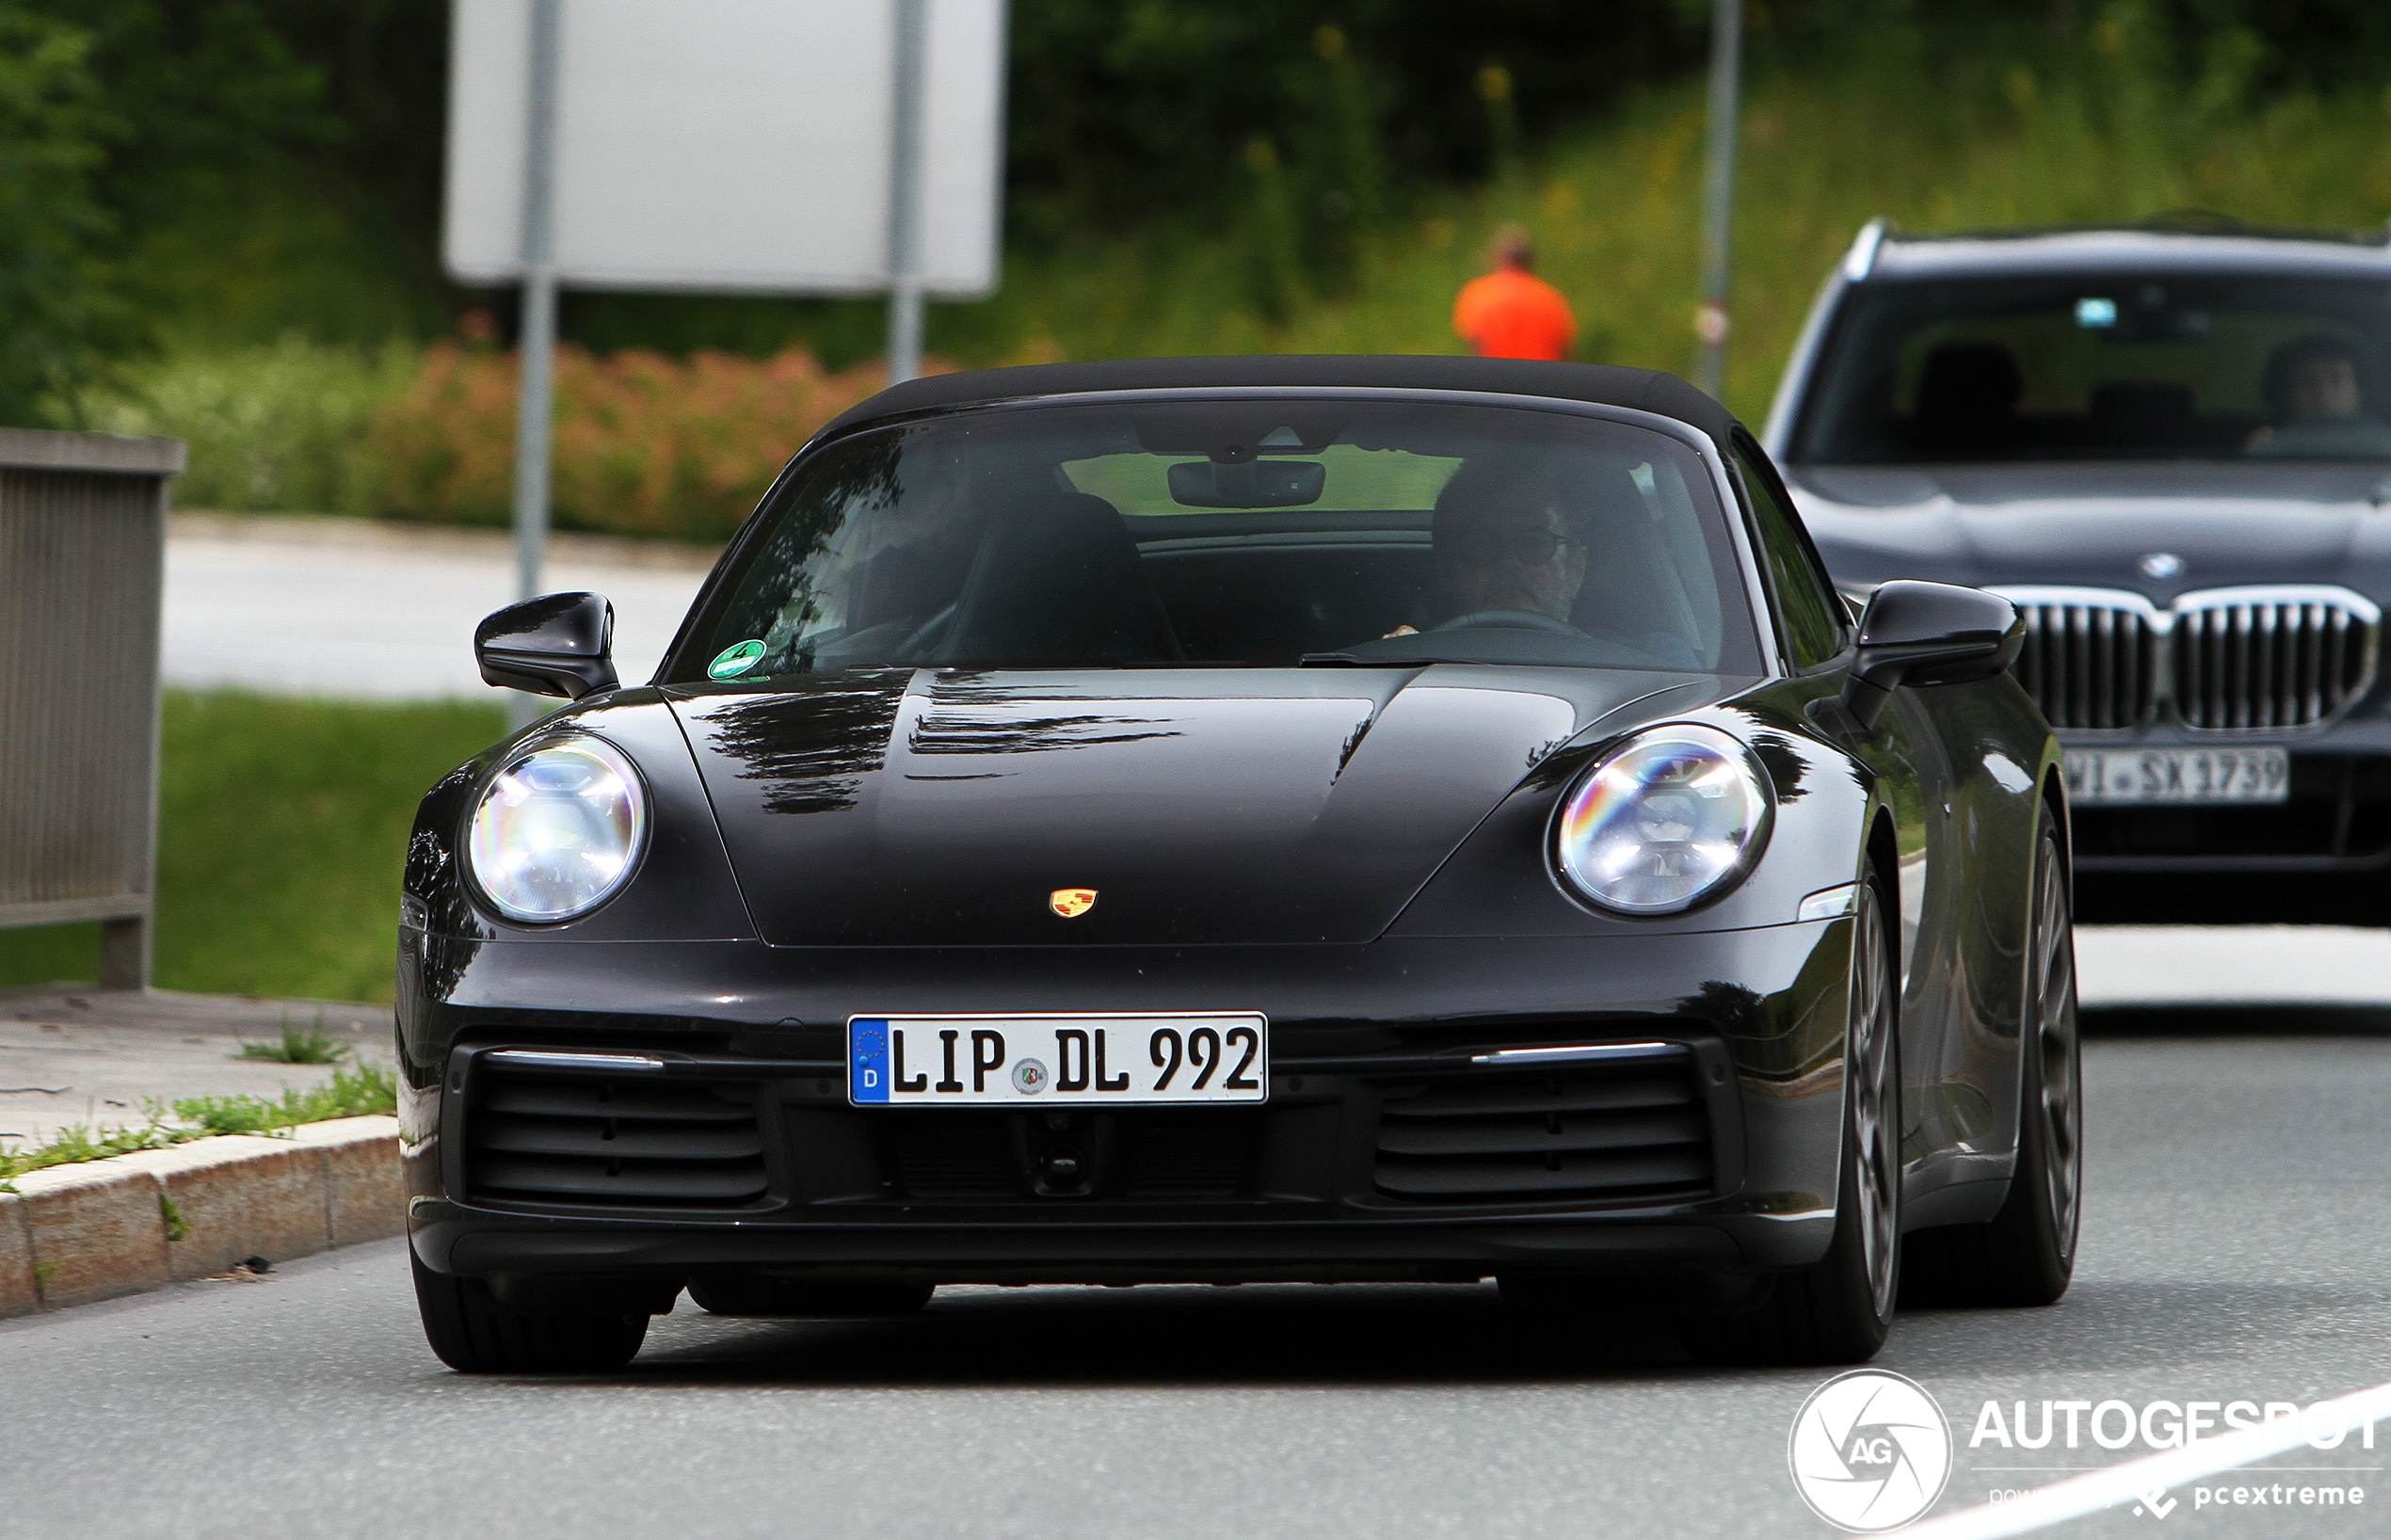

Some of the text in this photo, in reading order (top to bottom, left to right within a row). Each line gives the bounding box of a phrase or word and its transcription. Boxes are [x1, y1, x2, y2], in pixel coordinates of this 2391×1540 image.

[730, 642, 749, 659] 4
[892, 1029, 1005, 1093] LIP
[1055, 1028, 1130, 1092] DL
[1149, 1027, 1260, 1091] 992
[864, 1069, 877, 1088] D
